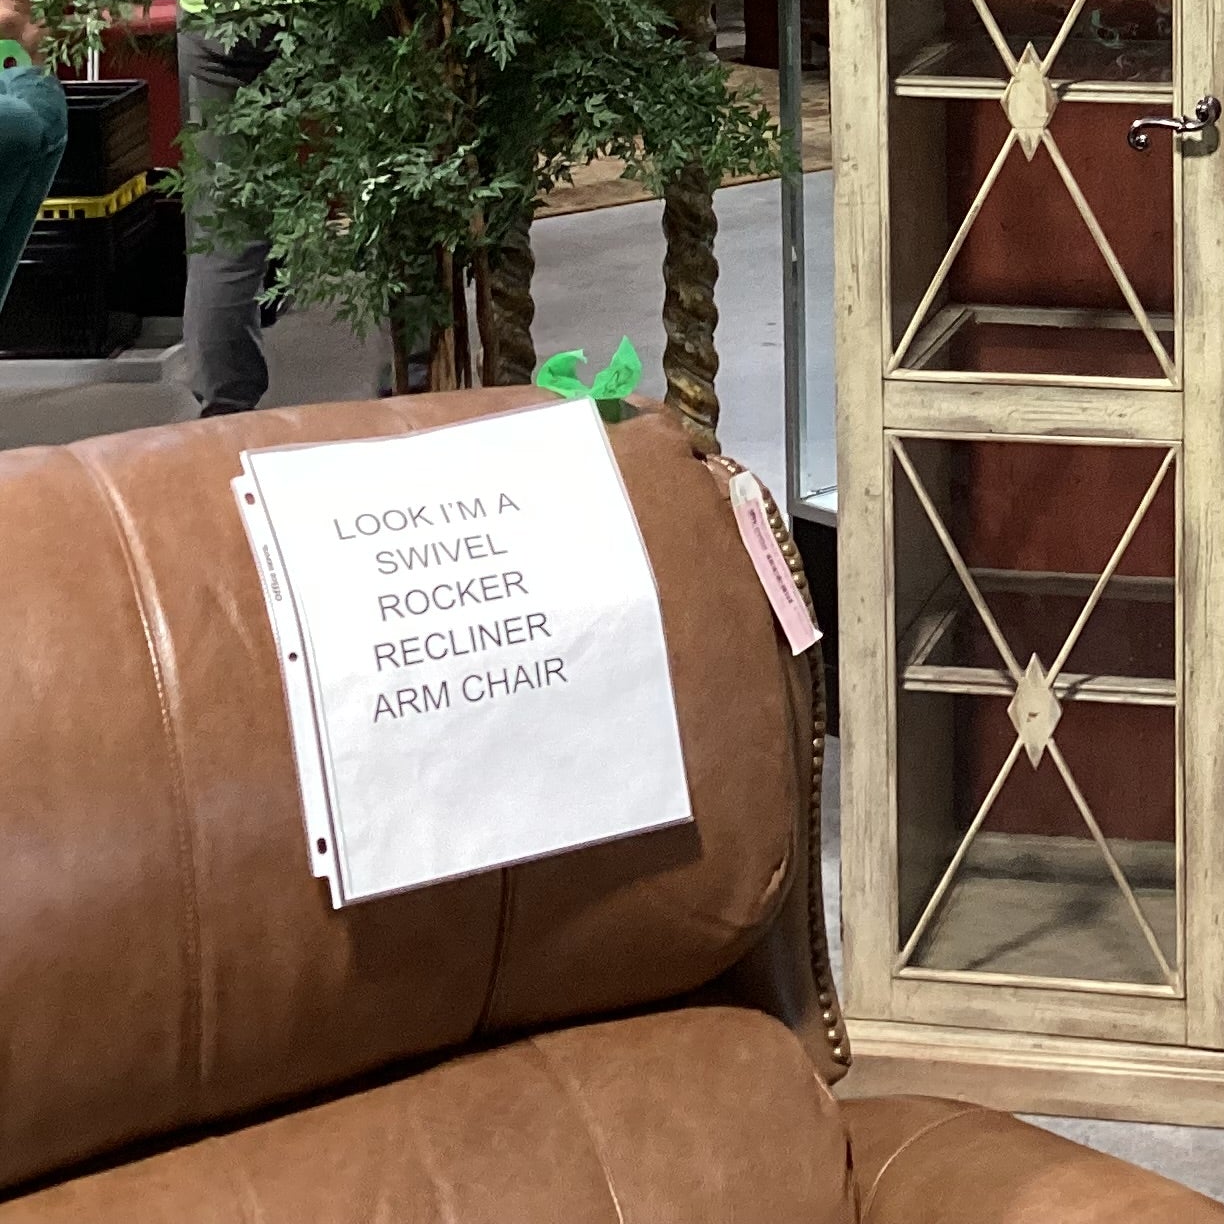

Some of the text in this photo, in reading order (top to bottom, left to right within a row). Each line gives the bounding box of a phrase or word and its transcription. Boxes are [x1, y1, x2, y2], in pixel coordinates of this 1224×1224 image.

[333, 492, 521, 540] LOOK I'M A
[375, 534, 509, 575] SWIVEL
[377, 571, 529, 622] ROCKER
[374, 612, 552, 672] RECLINER
[373, 657, 568, 724] ARM CHAIR
